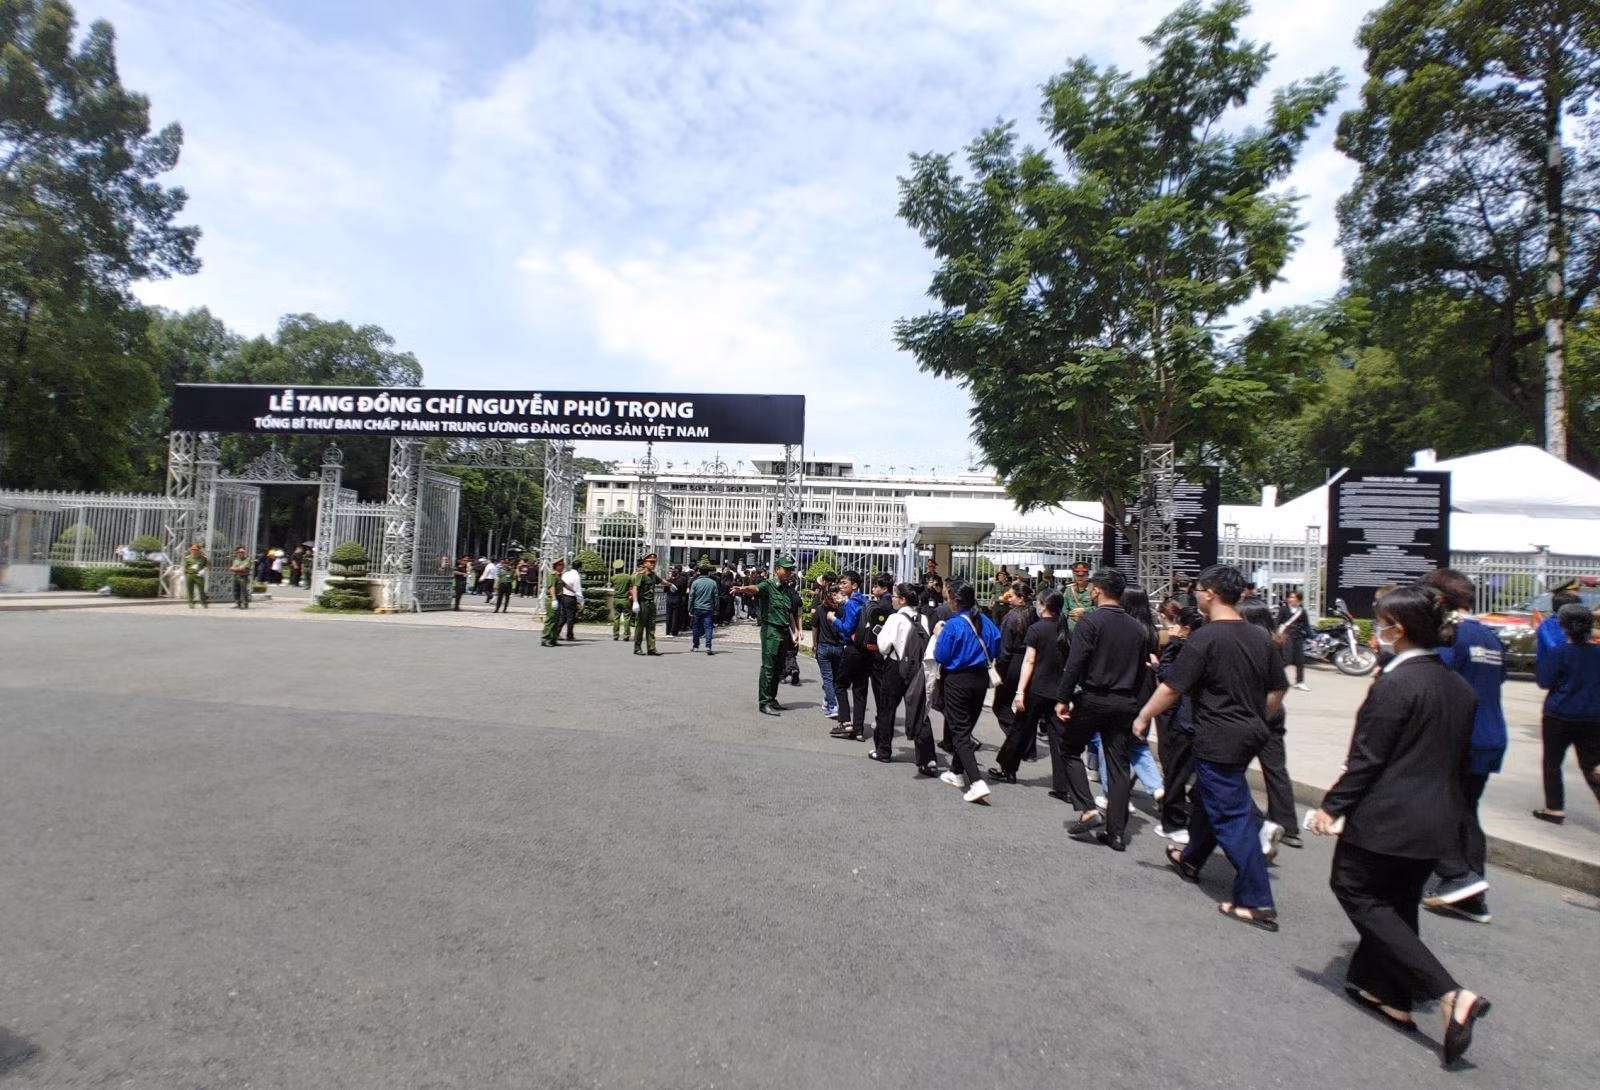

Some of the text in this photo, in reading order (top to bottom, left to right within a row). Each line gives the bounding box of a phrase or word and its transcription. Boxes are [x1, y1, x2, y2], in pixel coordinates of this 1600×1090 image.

[269, 390, 694, 422] LỄ TANG ĐỒNG CHÍ NGUYỄN PHÚ TRỌNG
[254, 414, 709, 439] TỔNG BÍ THƯ BAN CHẤP HÀNH TRUNG ƯƠNG ĐẢNG CỘNG SẢN VIỆT NAM
